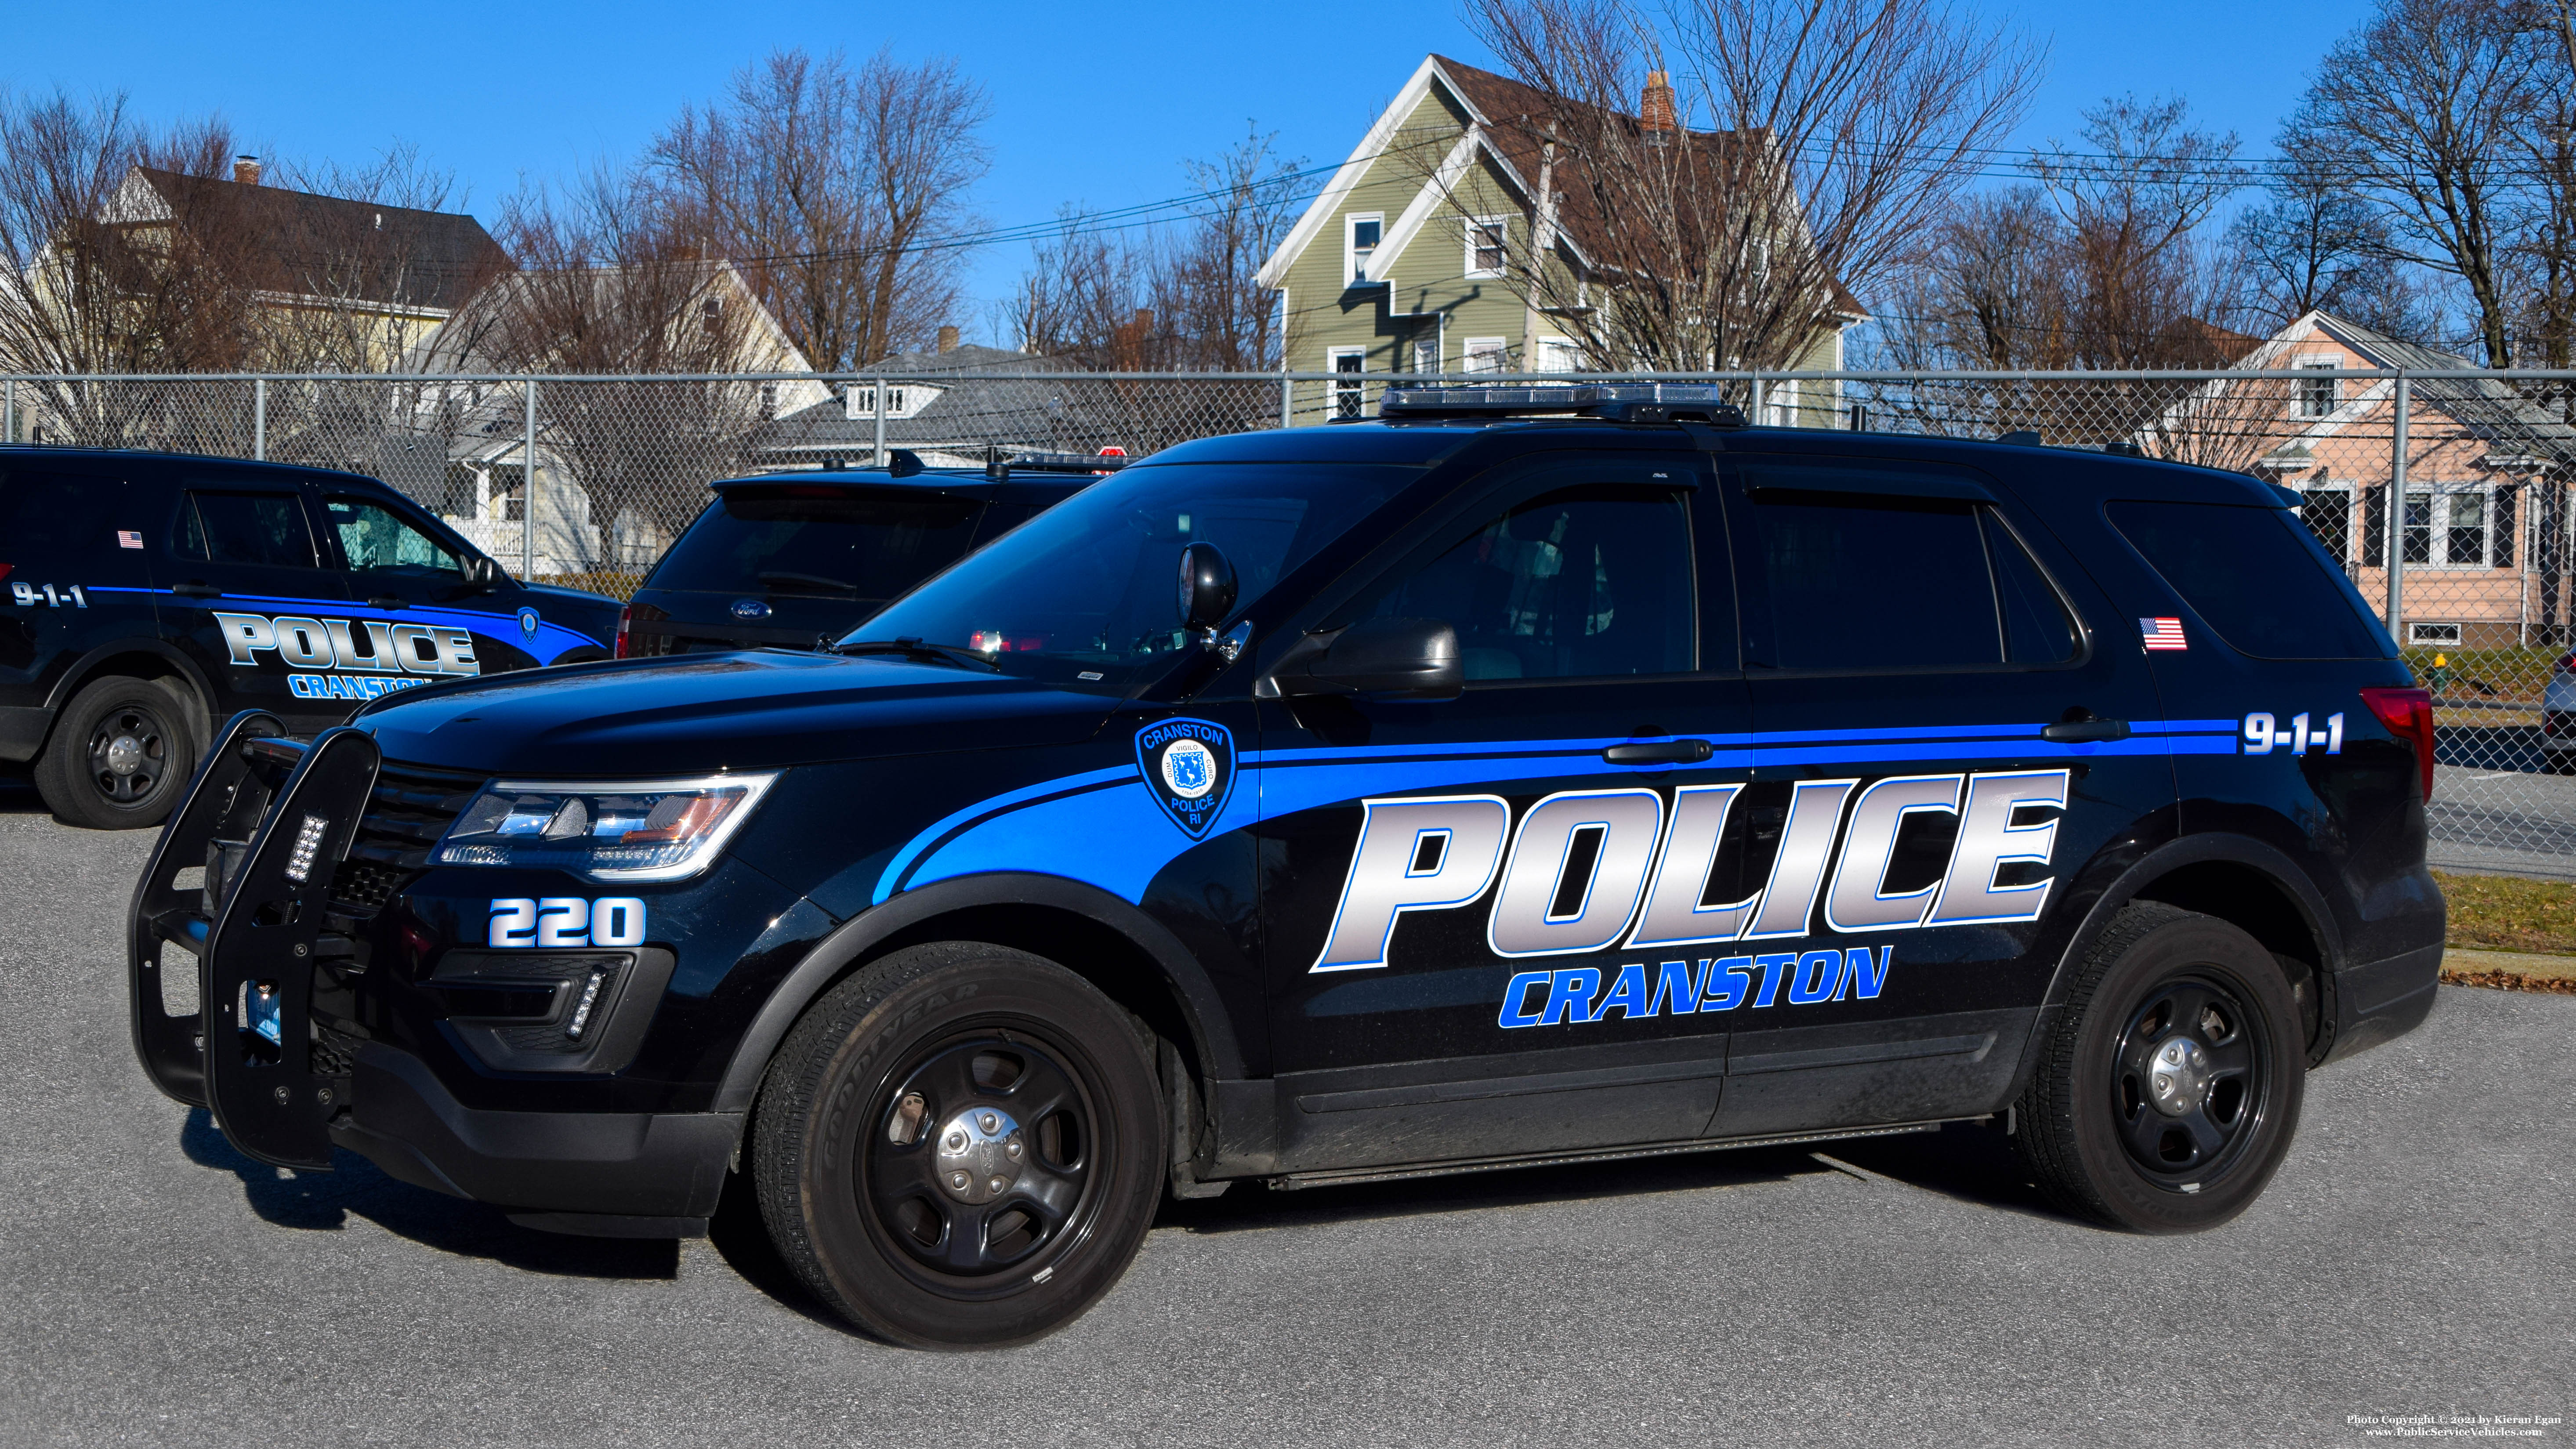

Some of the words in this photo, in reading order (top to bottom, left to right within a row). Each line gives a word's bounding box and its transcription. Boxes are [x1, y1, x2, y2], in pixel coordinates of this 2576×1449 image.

[12, 582, 88, 608] 9-1-1
[738, 603, 761, 615] Ford
[213, 612, 480, 676] POLICE
[287, 674, 433, 700] CRANST
[1143, 724, 1223, 750] CRANSTON
[2244, 712, 2344, 755] 9-1-1
[1171, 794, 1215, 812] POLICE
[1189, 813, 1201, 824] RI
[1309, 769, 2070, 974] POLICE
[489, 897, 646, 948] 220
[1498, 945, 1893, 1029] CRANSTON
[823, 983, 979, 1170] GOODYEAR
